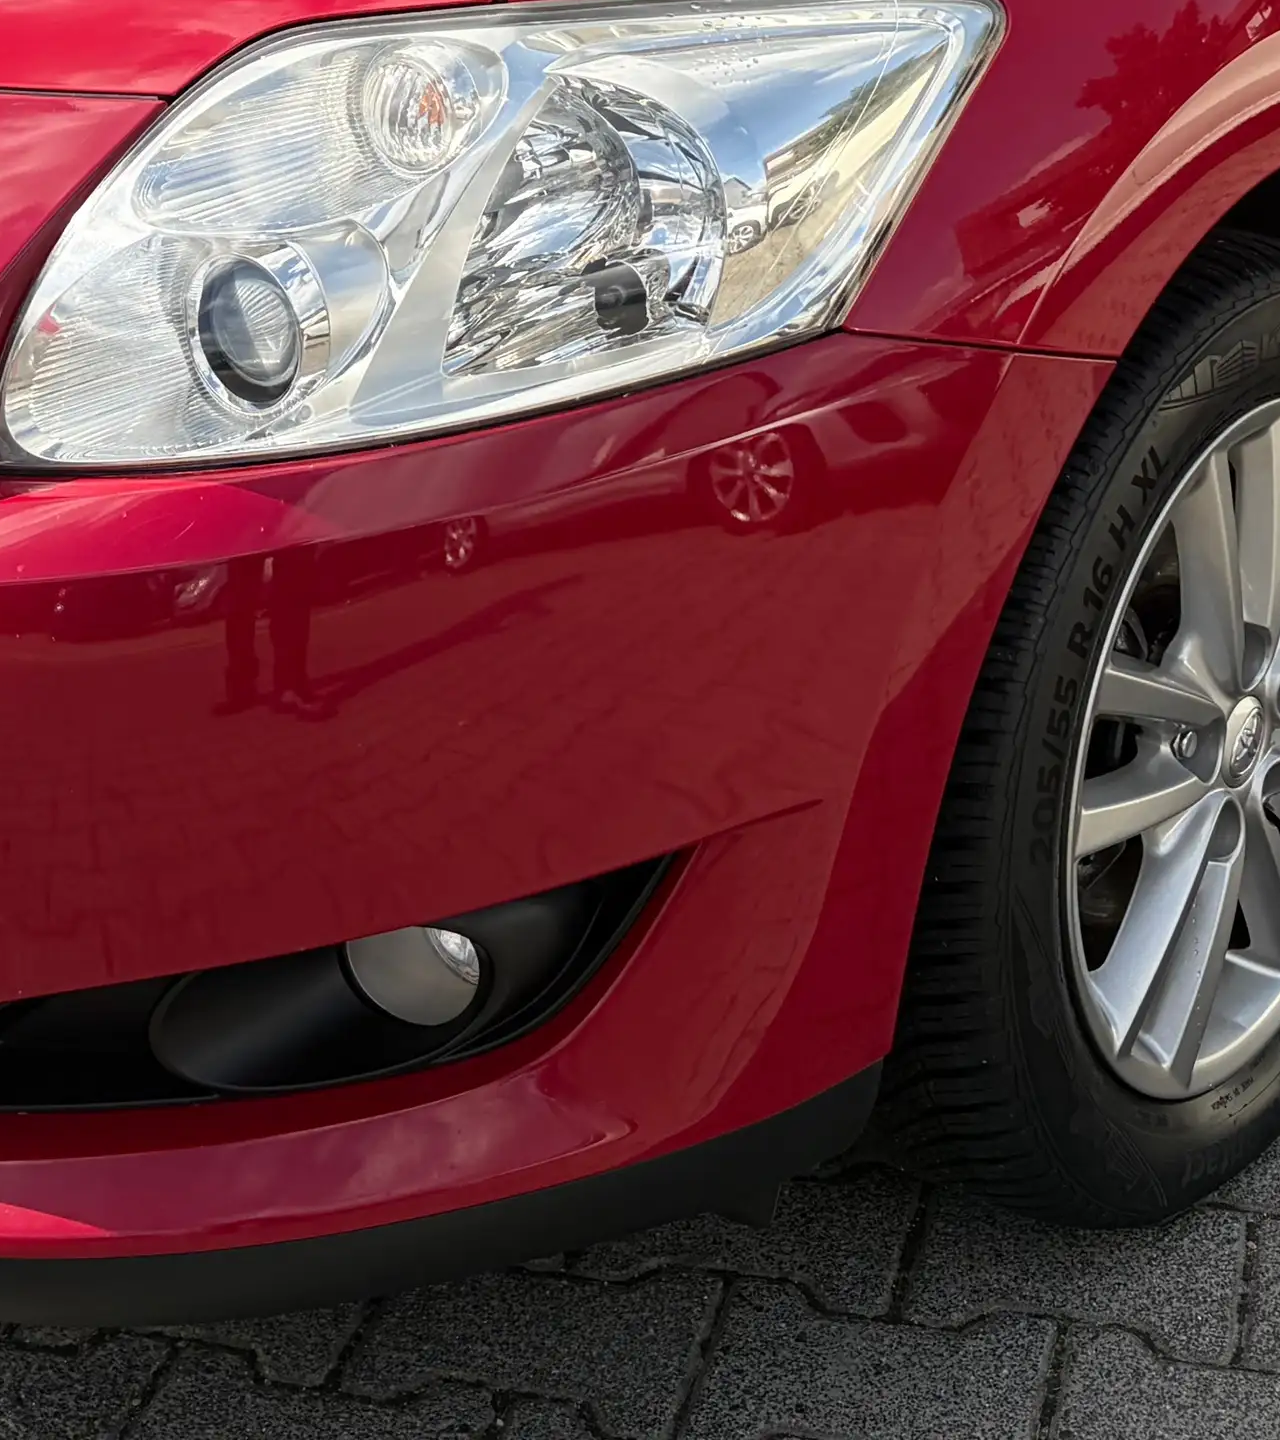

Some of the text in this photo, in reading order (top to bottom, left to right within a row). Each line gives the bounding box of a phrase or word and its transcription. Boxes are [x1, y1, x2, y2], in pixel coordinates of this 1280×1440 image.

[1030, 445, 1171, 867] 205/55 R 16 H XL
